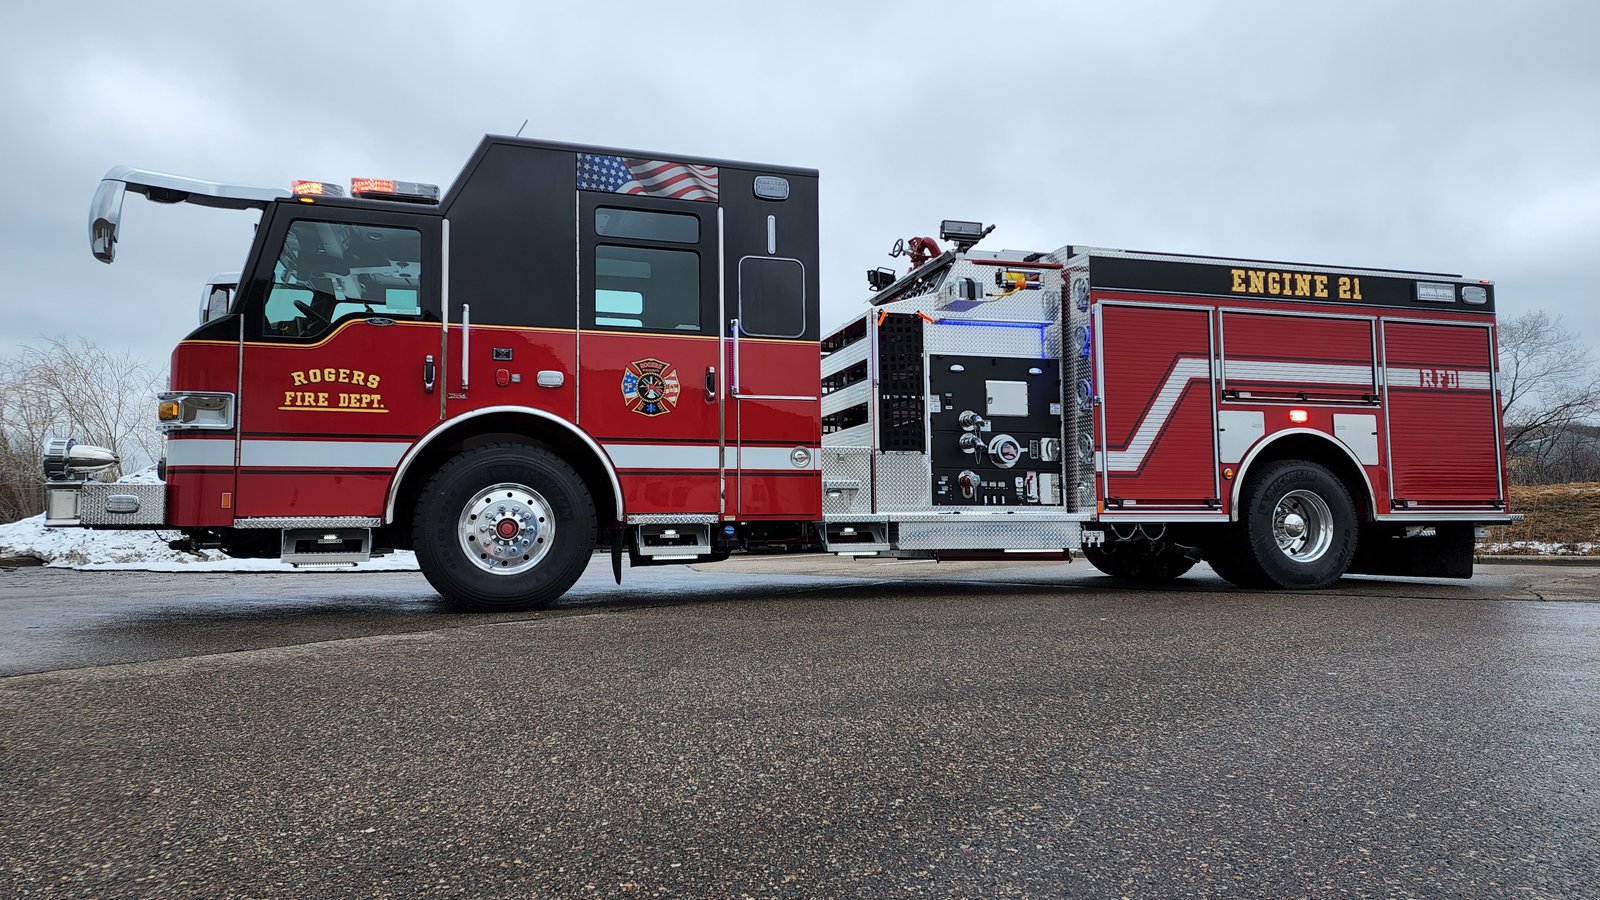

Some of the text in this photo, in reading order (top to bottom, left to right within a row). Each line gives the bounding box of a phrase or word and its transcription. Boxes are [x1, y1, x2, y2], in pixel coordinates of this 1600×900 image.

[1231, 269, 1362, 300] ENGINE 21
[291, 368, 380, 389] ROGERS
[1421, 368, 1458, 389] RFD
[284, 391, 385, 408] FIRE DEPT.
[1265, 470, 1317, 499] MICHELIN
